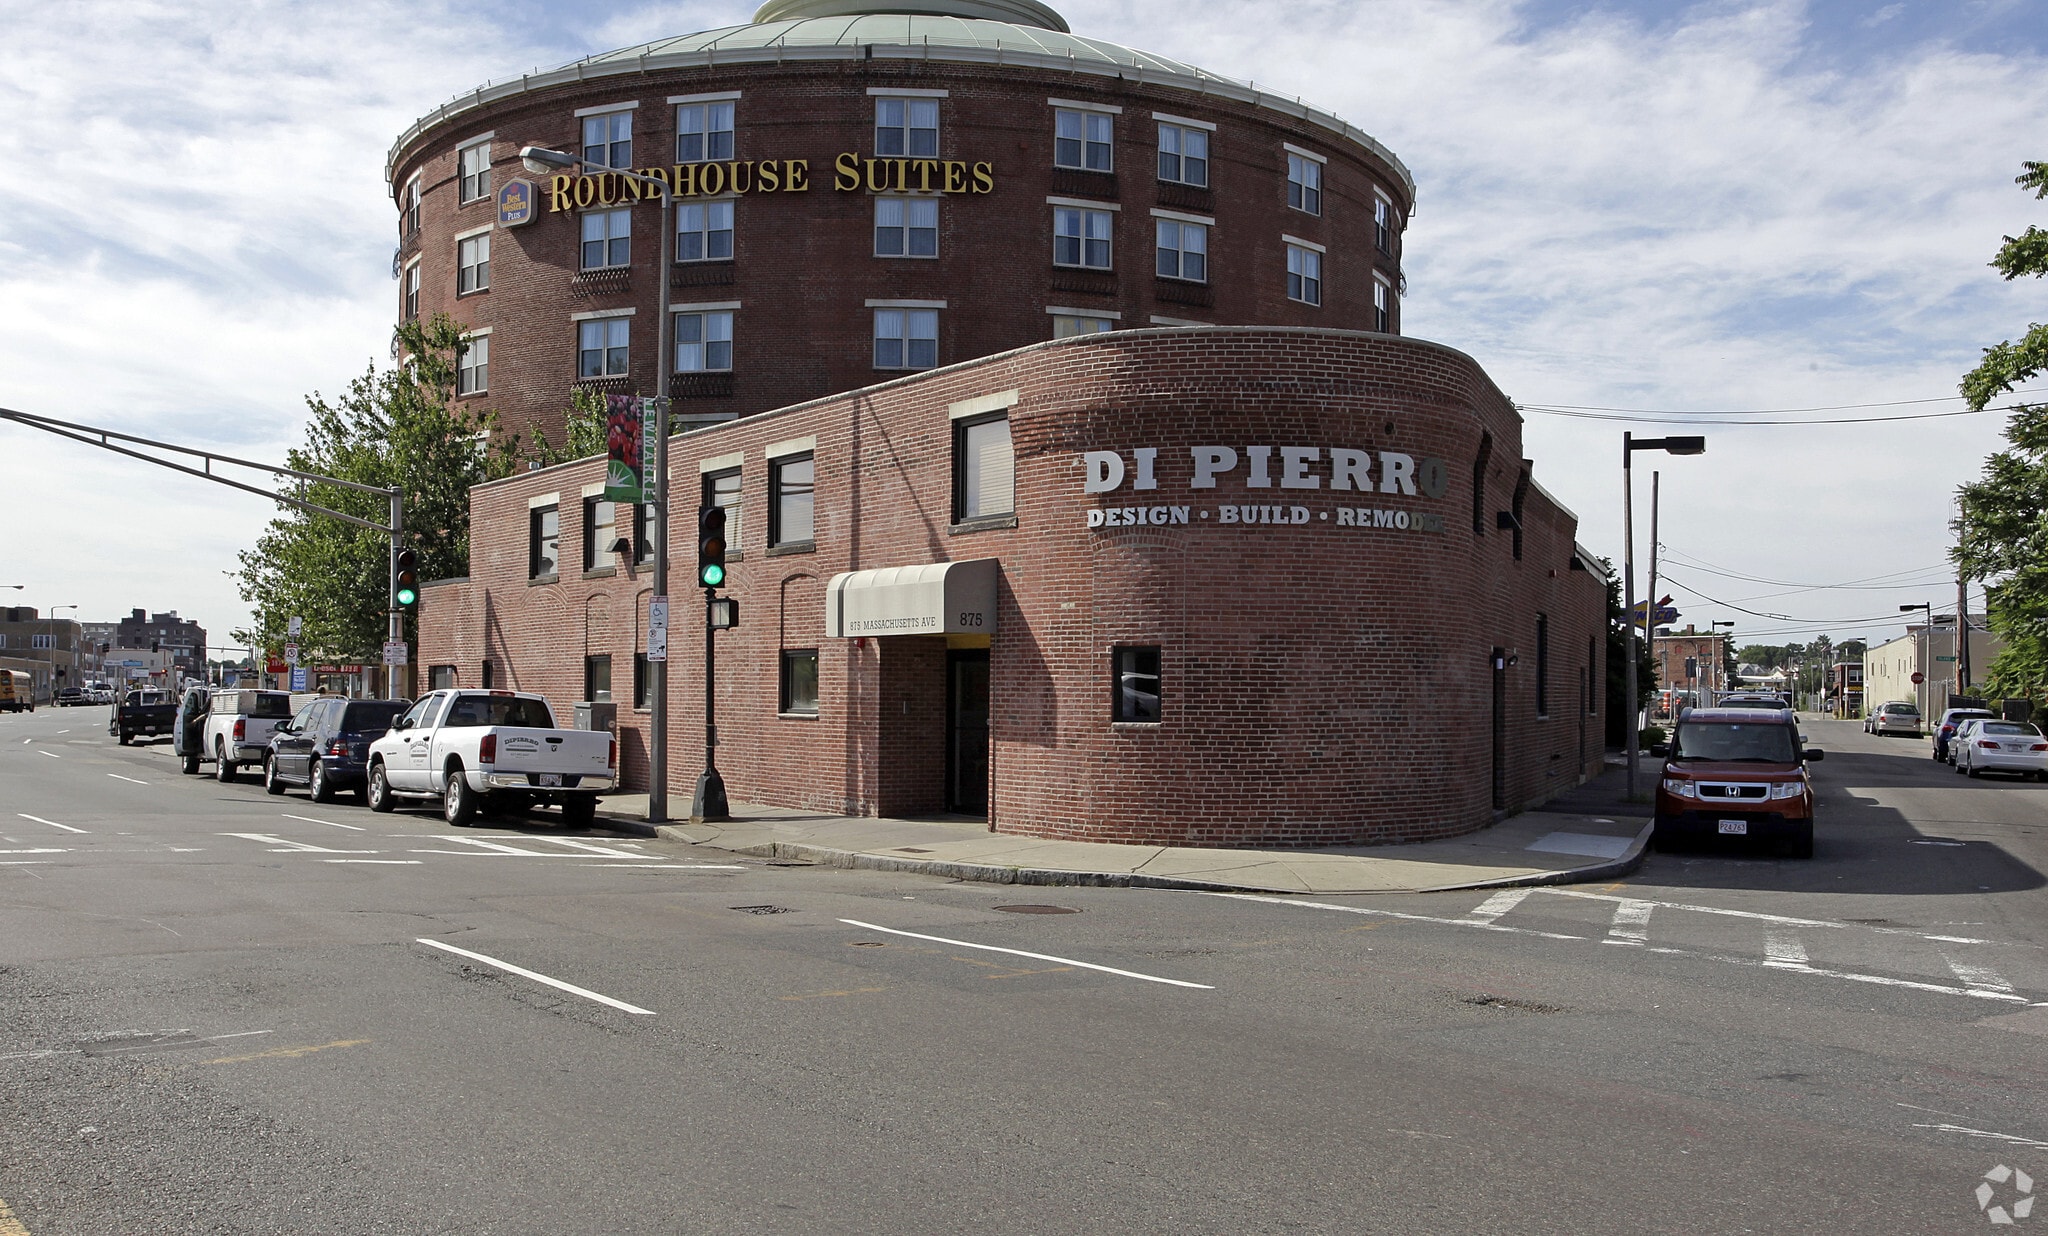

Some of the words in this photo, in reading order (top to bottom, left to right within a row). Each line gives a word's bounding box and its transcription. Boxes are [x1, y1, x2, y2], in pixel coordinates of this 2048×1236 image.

[549, 159, 809, 213] ROUNDHOUSE
[834, 152, 995, 195] SUITES
[1084, 447, 1158, 493] DI
[1190, 445, 1449, 499] PIERRO
[1087, 506, 1190, 528] DESIGN
[1218, 505, 1311, 525] BUILD
[850, 621, 861, 630] 875
[863, 617, 919, 630] MASSACHUSETTS
[921, 617, 936, 627] AVE
[960, 613, 983, 626] 875
